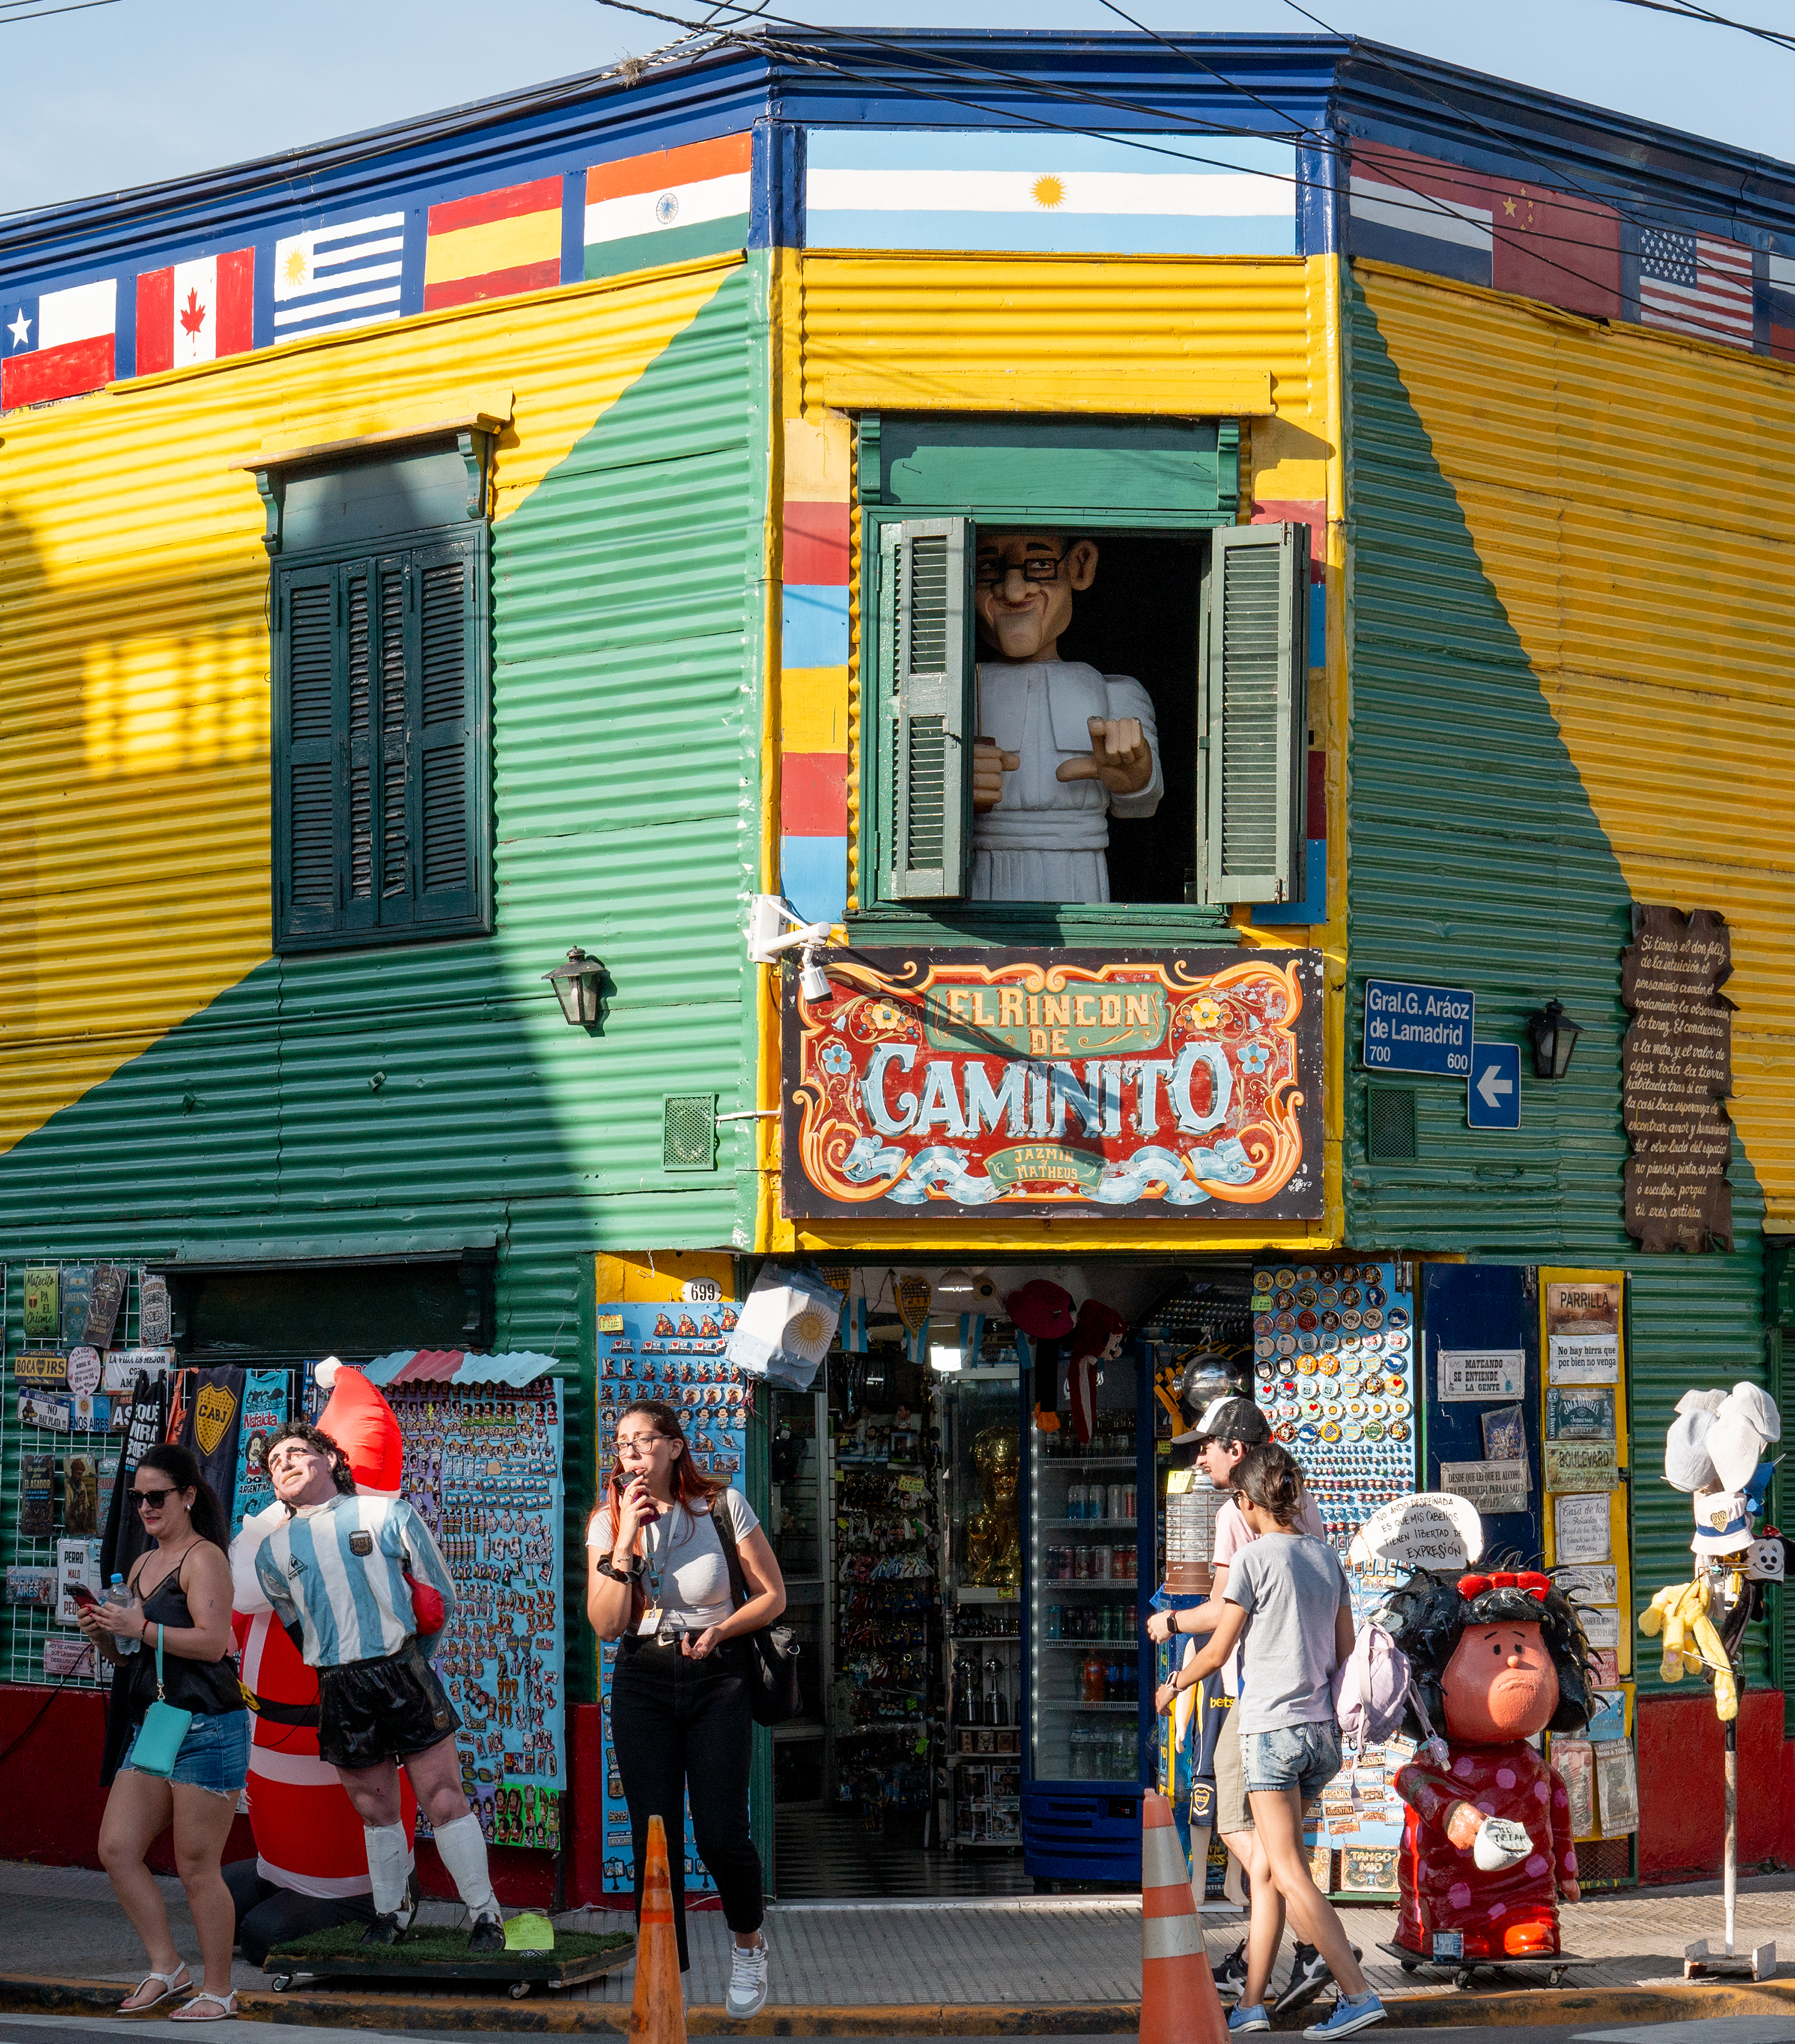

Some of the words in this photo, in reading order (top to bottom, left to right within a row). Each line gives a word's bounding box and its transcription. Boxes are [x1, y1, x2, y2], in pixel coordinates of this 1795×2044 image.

[1641, 935, 1653, 951] Si
[1653, 936, 1678, 953] tienes
[1680, 939, 1691, 952] el
[1691, 939, 1706, 954] don
[1641, 954, 1650, 968] de
[1652, 955, 1663, 969] la
[1663, 957, 1700, 974] intuición
[1701, 962, 1709, 974] el
[1707, 983, 1714, 995] el
[945, 989, 994, 1027] EL
[1425, 996, 1470, 1020] Aráoz
[1679, 1000, 1689, 1013] la
[1370, 1017, 1389, 1039] de
[1392, 1019, 1462, 1045] Lamadrid
[1636, 1015, 1647, 1029] lo
[1674, 1018, 1684, 1034] El
[1684, 1023, 1724, 1037] conducirte
[1029, 1029, 1071, 1056] DE
[1370, 1046, 1391, 1062] 700
[1633, 1041, 1641, 1052] a
[1640, 1039, 1651, 1054] la
[1653, 1042, 1673, 1057] meta,
[1672, 1046, 1681, 1062] y
[1681, 1044, 1692, 1057] el
[1693, 1045, 1715, 1060] valor
[1715, 1048, 1725, 1060] de
[1447, 1053, 1468, 1070] 600
[1630, 1058, 1654, 1078] dejar
[1658, 1060, 1681, 1075] toda
[1683, 1064, 1696, 1077] la
[1697, 1064, 1725, 1080] tierra
[860, 1041, 1233, 1140] CAMINITO
[1626, 1075, 1667, 1091] habitada
[1667, 1079, 1685, 1093] tras
[1687, 1081, 1694, 1094] si
[1695, 1085, 1708, 1094] con
[1625, 1095, 1636, 1108] la
[1637, 1097, 1655, 1111] casi
[1655, 1097, 1674, 1111] loca
[1675, 1102, 1709, 1118] esperanza
[1710, 1102, 1718, 1115] de
[1628, 1118, 1667, 1133] encontrar
[1668, 1121, 1688, 1133] amor
[1688, 1124, 1695, 1140] y
[1696, 1121, 1730, 1136] humanidad
[1650, 1139, 1668, 1153] otro
[1668, 1139, 1688, 1153] lado
[1690, 1140, 1701, 1154] del
[1702, 1142, 1727, 1158] espacio
[1014, 1148, 1074, 1163] JAZMIN
[1015, 1165, 1078, 1180] MATHEUS
[1635, 1163, 1645, 1173] no
[1698, 1164, 1706, 1174] se
[1706, 1161, 1723, 1178] poeta
[1678, 1185, 1706, 1201] porque
[1648, 1206, 1668, 1218] eres
[26, 1273, 54, 1288] Matecito
[142, 1282, 165, 1294] ARGENTINO
[691, 1283, 715, 1301] 699
[41, 1291, 48, 1301] PA
[1560, 1292, 1608, 1308] PARRILLA
[42, 1304, 51, 1313] EL
[26, 1312, 54, 1324] Chisme
[1558, 1346, 1568, 1355] No
[1570, 1346, 1582, 1356] hay
[1584, 1346, 1602, 1354] birra
[1604, 1348, 1616, 1356] que
[17, 1360, 35, 1373] BOCA
[1465, 1359, 1503, 1368] MATEANDO
[1559, 1360, 1569, 1368] por
[1571, 1358, 1585, 1366] bien
[1597, 1359, 1616, 1367] venga
[1454, 1371, 1461, 1382] SE
[1465, 1371, 1498, 1382] ENTIENDE
[34, 1393, 55, 1403] ARGENTINA
[47, 1405, 57, 1415] NO
[198, 1404, 228, 1424] CABJ
[38, 1415, 47, 1424] HAY
[48, 1417, 60, 1428] PLATA
[89, 1418, 109, 1430] AIRES
[1559, 1451, 1608, 1467] BOULEVARD
[1449, 1474, 1464, 1483] DESDE
[1466, 1473, 1475, 1483] QUE
[1485, 1472, 1495, 1482] QUE
[1496, 1471, 1501, 1480] EL
[25, 1480, 29, 1489] EL
[31, 1479, 51, 1489] ASADOR
[239, 1483, 270, 1494] ARGENTINA
[1490, 1485, 1502, 1494] PARA
[1503, 1484, 1509, 1493] LA
[1377, 1512, 1387, 1522] NO
[1391, 1502, 1408, 1514] ANDO
[1563, 1505, 1581, 1517] Casa
[1585, 1504, 1593, 1514] de
[1596, 1503, 1605, 1513] los
[1382, 1523, 1392, 1532] ES
[1395, 1517, 1408, 1527] QUE
[64, 1551, 83, 1564] PERRO
[10, 1574, 39, 1585] BUENOS
[68, 1569, 80, 1579] MALO
[16, 1585, 38, 1598] AIRES
[1210, 1696, 1235, 1708] bets
[1391, 1742, 1413, 1754] ARGENTINA
[1327, 1806, 1353, 1815] ARGENTINA
[1350, 1851, 1392, 1863] TANGO
